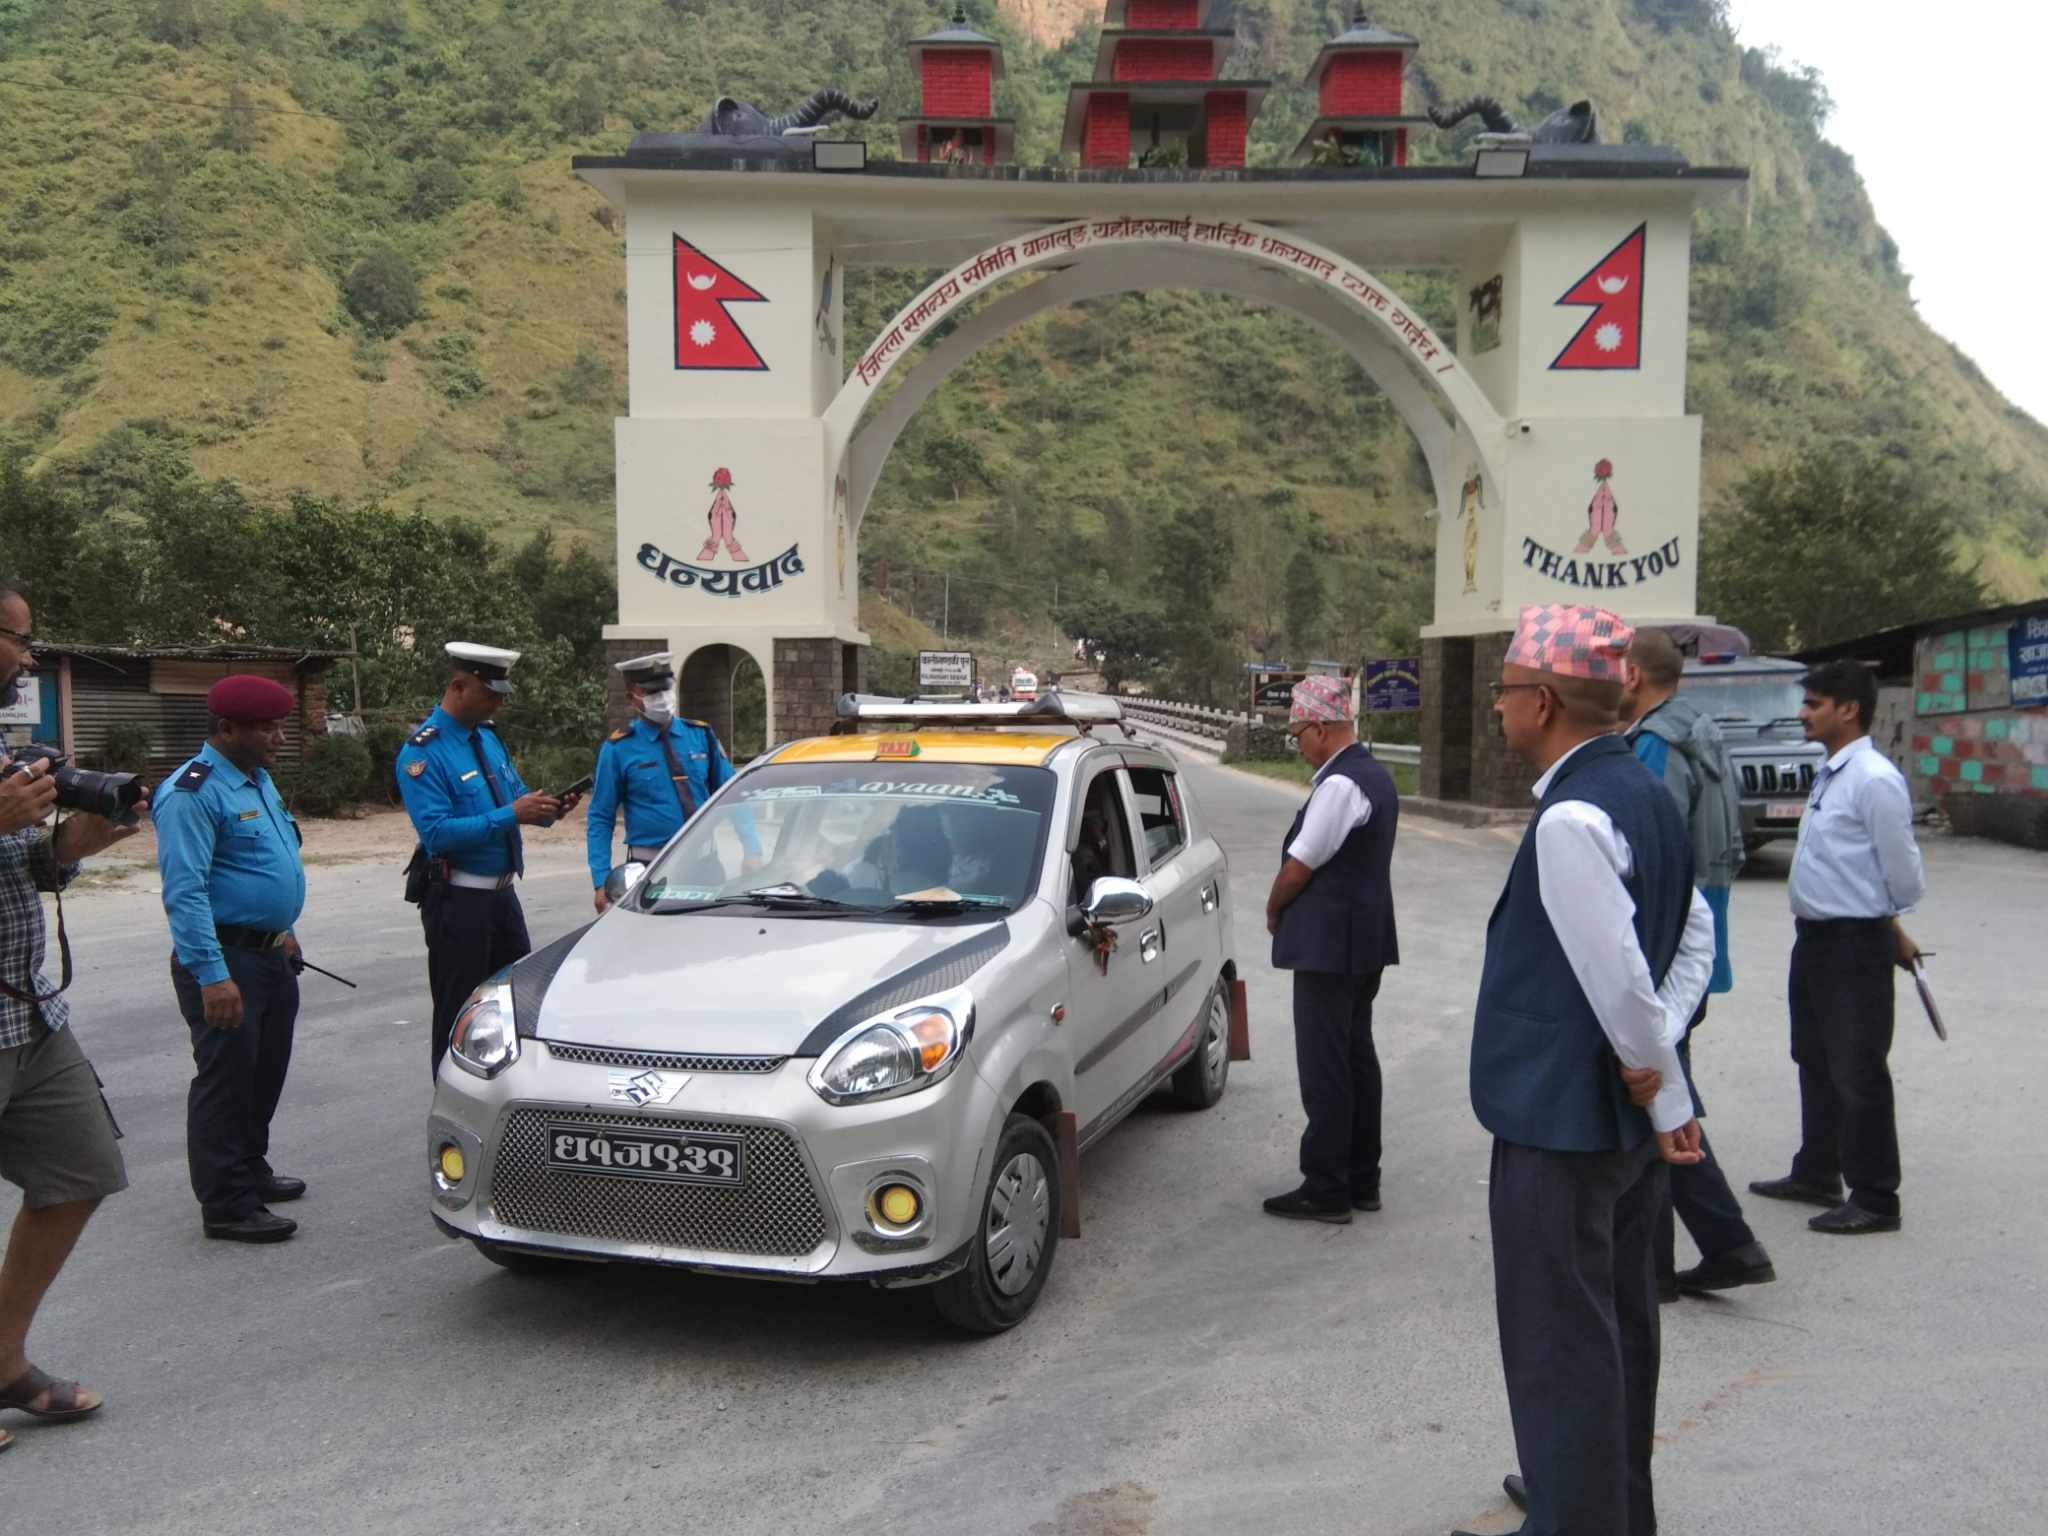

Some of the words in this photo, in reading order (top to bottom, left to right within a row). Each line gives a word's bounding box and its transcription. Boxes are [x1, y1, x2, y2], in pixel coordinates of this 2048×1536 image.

[901, 278, 960, 333] समन्वय
[960, 245, 1017, 284] समिति
[1260, 237, 1338, 280] धन्यवाद
[636, 542, 805, 598] धन्यवाद
